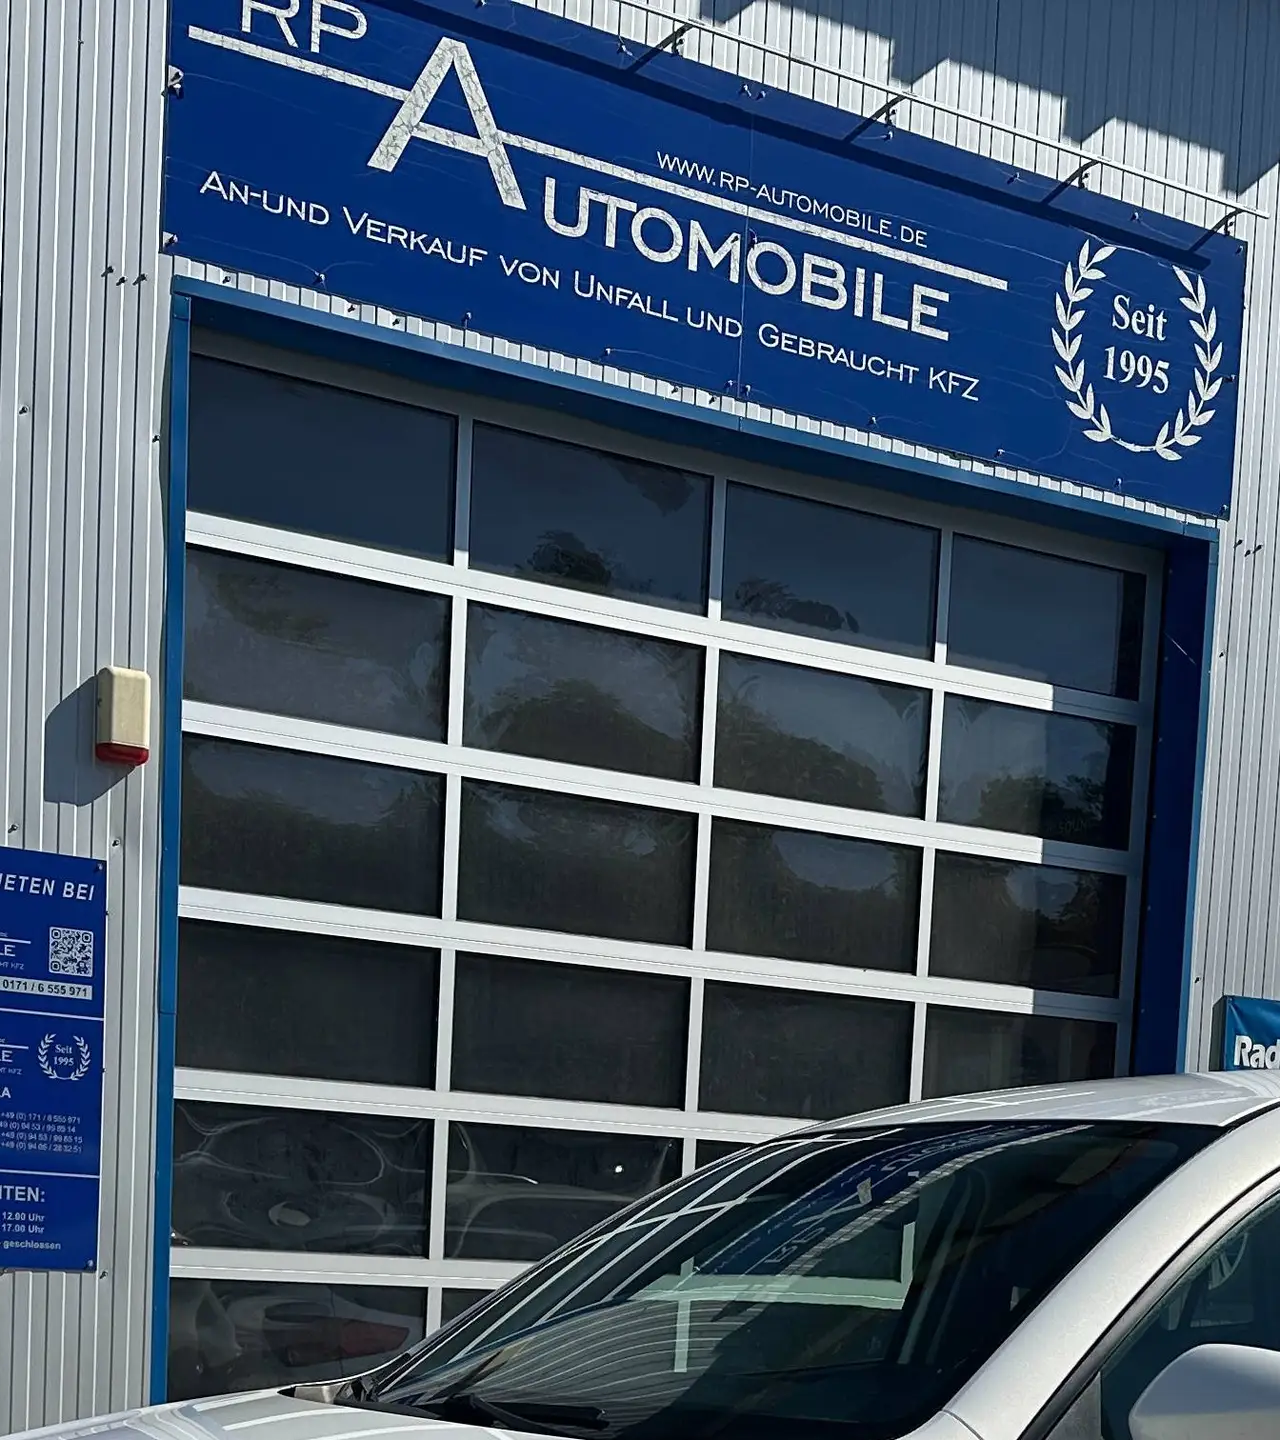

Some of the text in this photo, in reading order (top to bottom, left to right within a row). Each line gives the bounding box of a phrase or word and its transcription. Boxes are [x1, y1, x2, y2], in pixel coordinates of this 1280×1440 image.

[241, 0, 368, 53] RP
[366, 36, 950, 342] AUTOMOBILE
[199, 171, 980, 402] AN-UND VERKAUF VON UNFALL UND GEBRAUCHT KFZ
[1110, 292, 1168, 341] Seit
[1102, 345, 1170, 396] 1995
[63, 881, 94, 901] BEI
[2, 979, 27, 991] 0171
[30, 980, 35, 992] /
[38, 982, 44, 992] 6
[48, 983, 67, 995] 555
[69, 985, 88, 997] 971
[55, 1043, 73, 1055] Seit
[53, 1056, 74, 1067] 1995
[2, 1211, 26, 1222] 12.00
[28, 1212, 45, 1223] Uhr
[2, 1223, 26, 1233] 17.00
[28, 1224, 45, 1234] Uhr
[3, 1238, 61, 1251] geschlossen
